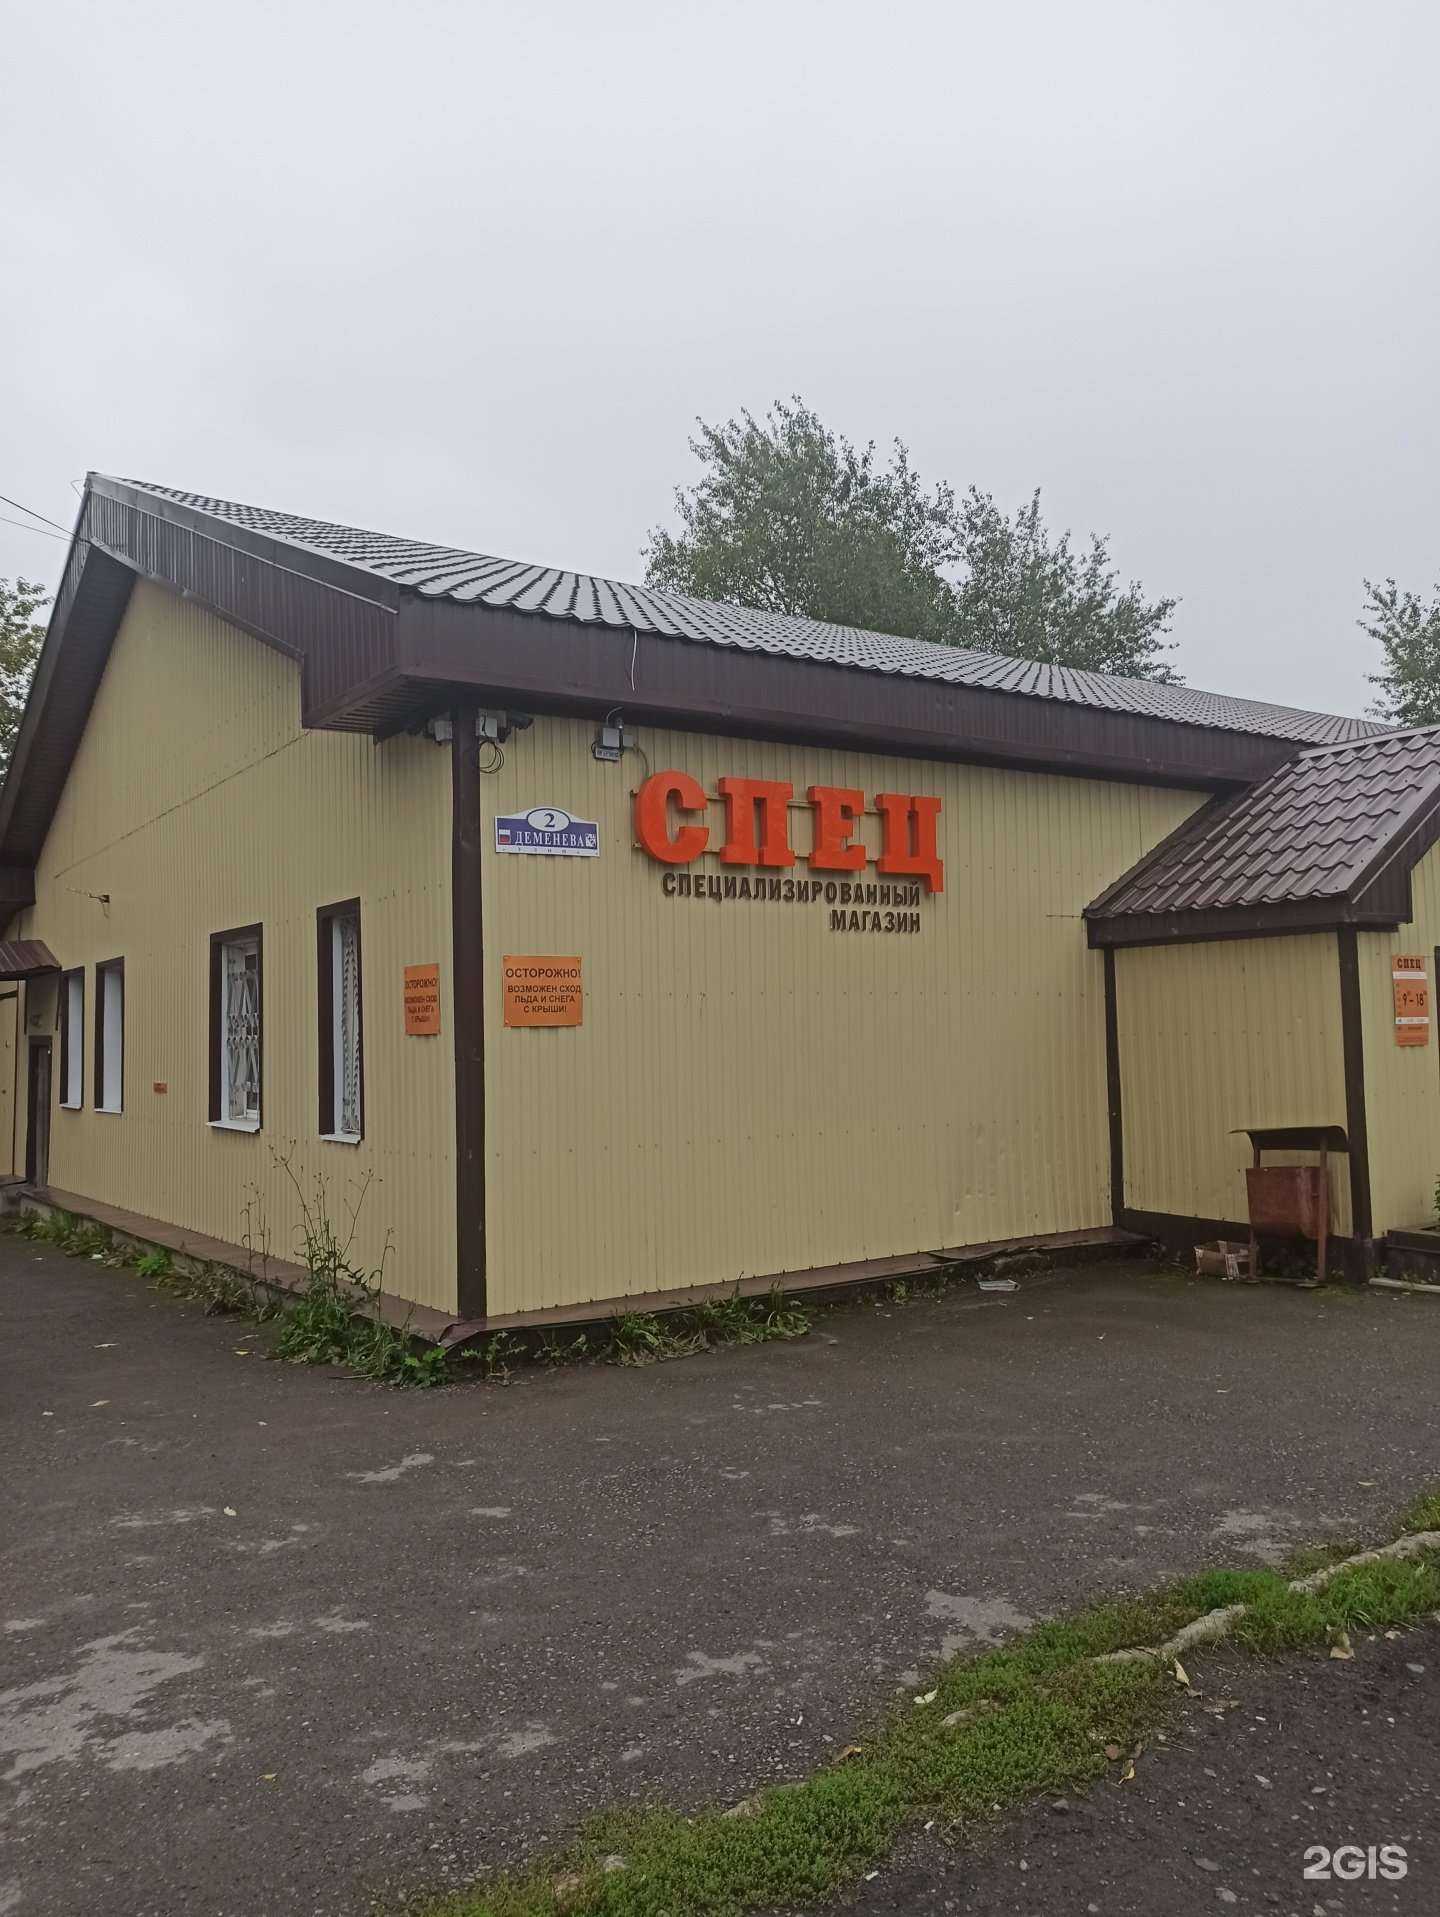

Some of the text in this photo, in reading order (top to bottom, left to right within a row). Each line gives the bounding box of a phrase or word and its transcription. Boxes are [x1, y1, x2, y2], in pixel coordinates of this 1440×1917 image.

[543, 812, 556, 828] 2
[635, 770, 944, 892] СПЕЦ
[515, 831, 583, 847] ДЕМЕНЕВА
[662, 872, 921, 907] СПЕЦИАЛИЗИРОВАННЫЙ
[831, 909, 921, 933] МАГАЗИН
[1397, 958, 1421, 970] СПЕЦ
[505, 968, 582, 979] ОСТОРОЖНО!
[507, 985, 582, 995] ВОЗМОЖЕН СХОД
[540, 995, 548, 1003] И
[549, 995, 576, 1003] СНЕГА
[523, 1005, 530, 1013] С
